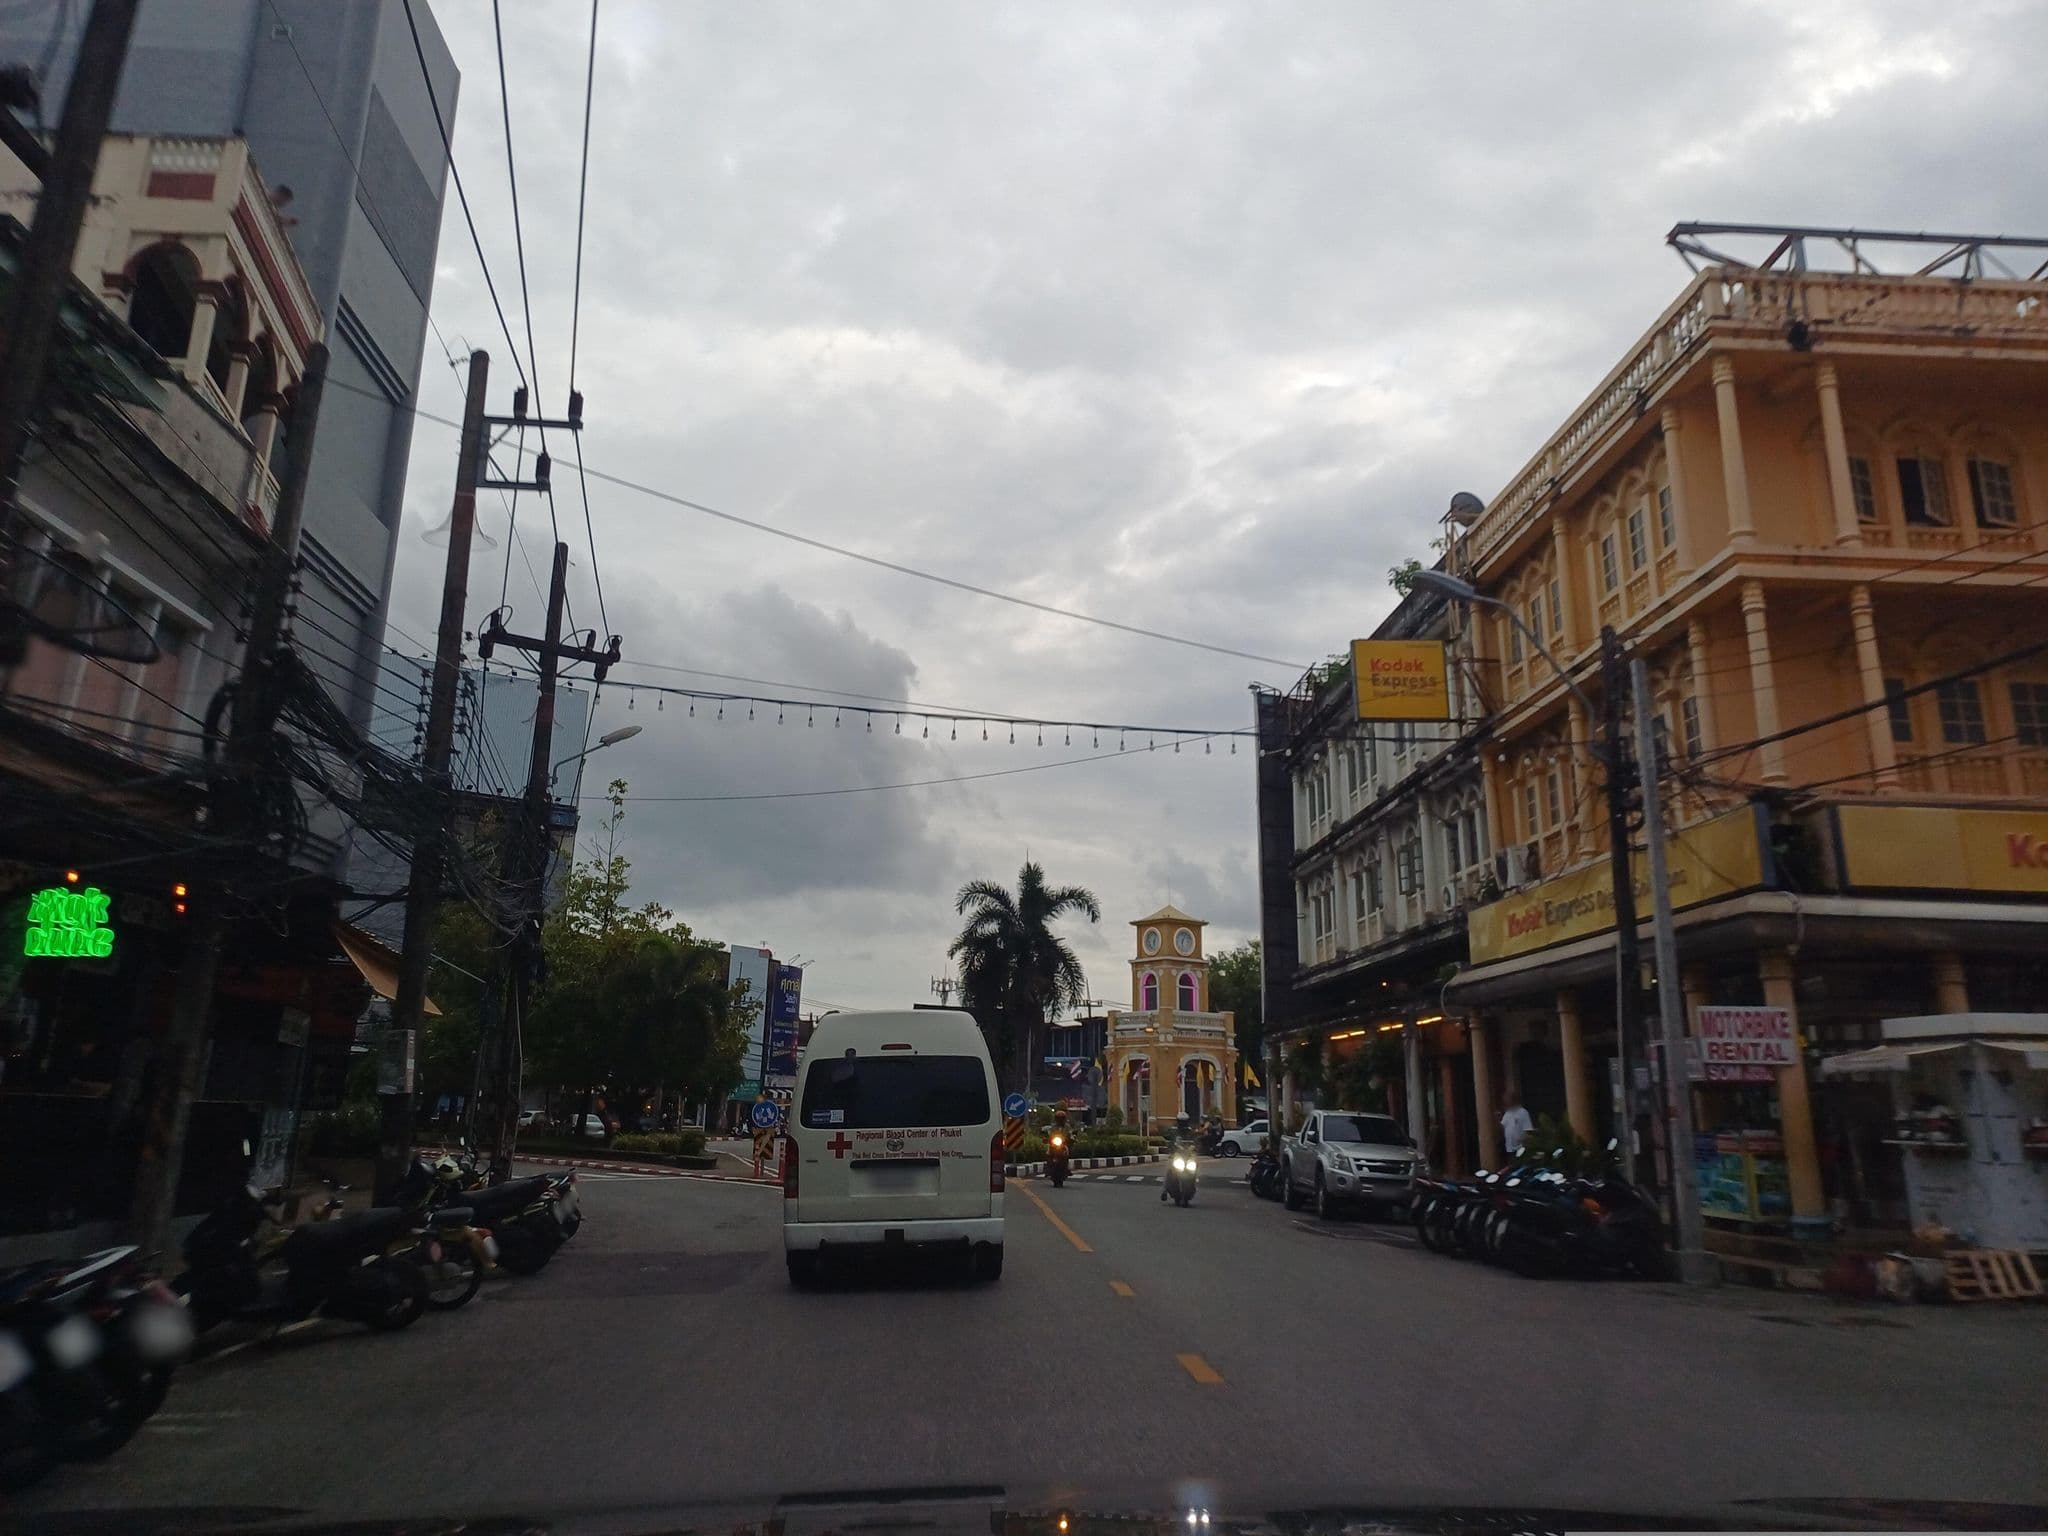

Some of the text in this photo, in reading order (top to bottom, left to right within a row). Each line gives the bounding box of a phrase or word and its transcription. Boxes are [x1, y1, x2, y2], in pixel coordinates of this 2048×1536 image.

[1370, 657, 1424, 672] Kodak
[1372, 673, 1438, 690] Express
[1544, 893, 1597, 927] Express
[1701, 1011, 1792, 1037] MOTORBIKE
[1708, 1042, 1788, 1061] RENTAL
[856, 1131, 884, 1142] Regional
[906, 1130, 928, 1138] Center
[940, 1128, 962, 1138] Phuket
